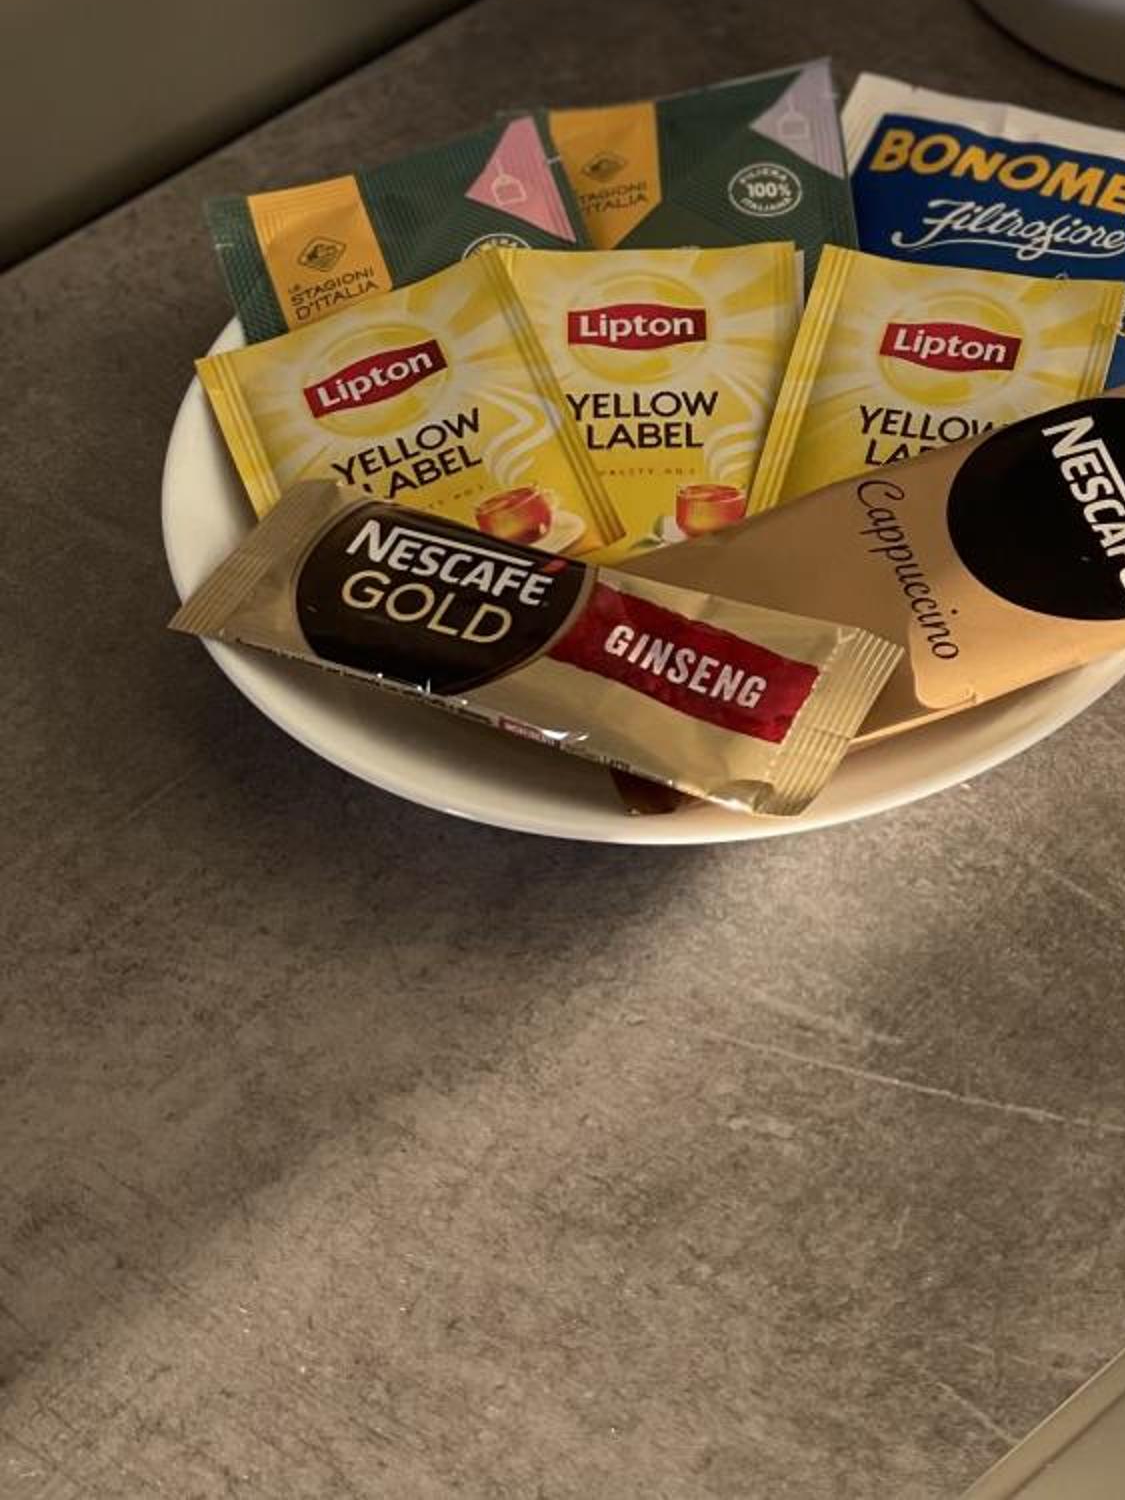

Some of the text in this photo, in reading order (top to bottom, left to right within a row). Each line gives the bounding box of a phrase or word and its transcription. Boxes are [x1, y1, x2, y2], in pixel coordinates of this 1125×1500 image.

[746, 182, 792, 199] 100%
[290, 266, 375, 306] STAGIONI
[296, 280, 380, 321] D'ITALIA
[578, 312, 697, 344] Lipton
[893, 327, 1007, 364] Lipton
[315, 348, 434, 407] Lipton
[566, 391, 719, 421] YELLOW
[331, 407, 479, 486] YELLOW
[586, 422, 704, 450] LABEL
[362, 445, 484, 500] ABEL
[857, 480, 960, 660] Cappuccino
[341, 569, 512, 644] GOLD
[603, 624, 768, 709] GINSENG
